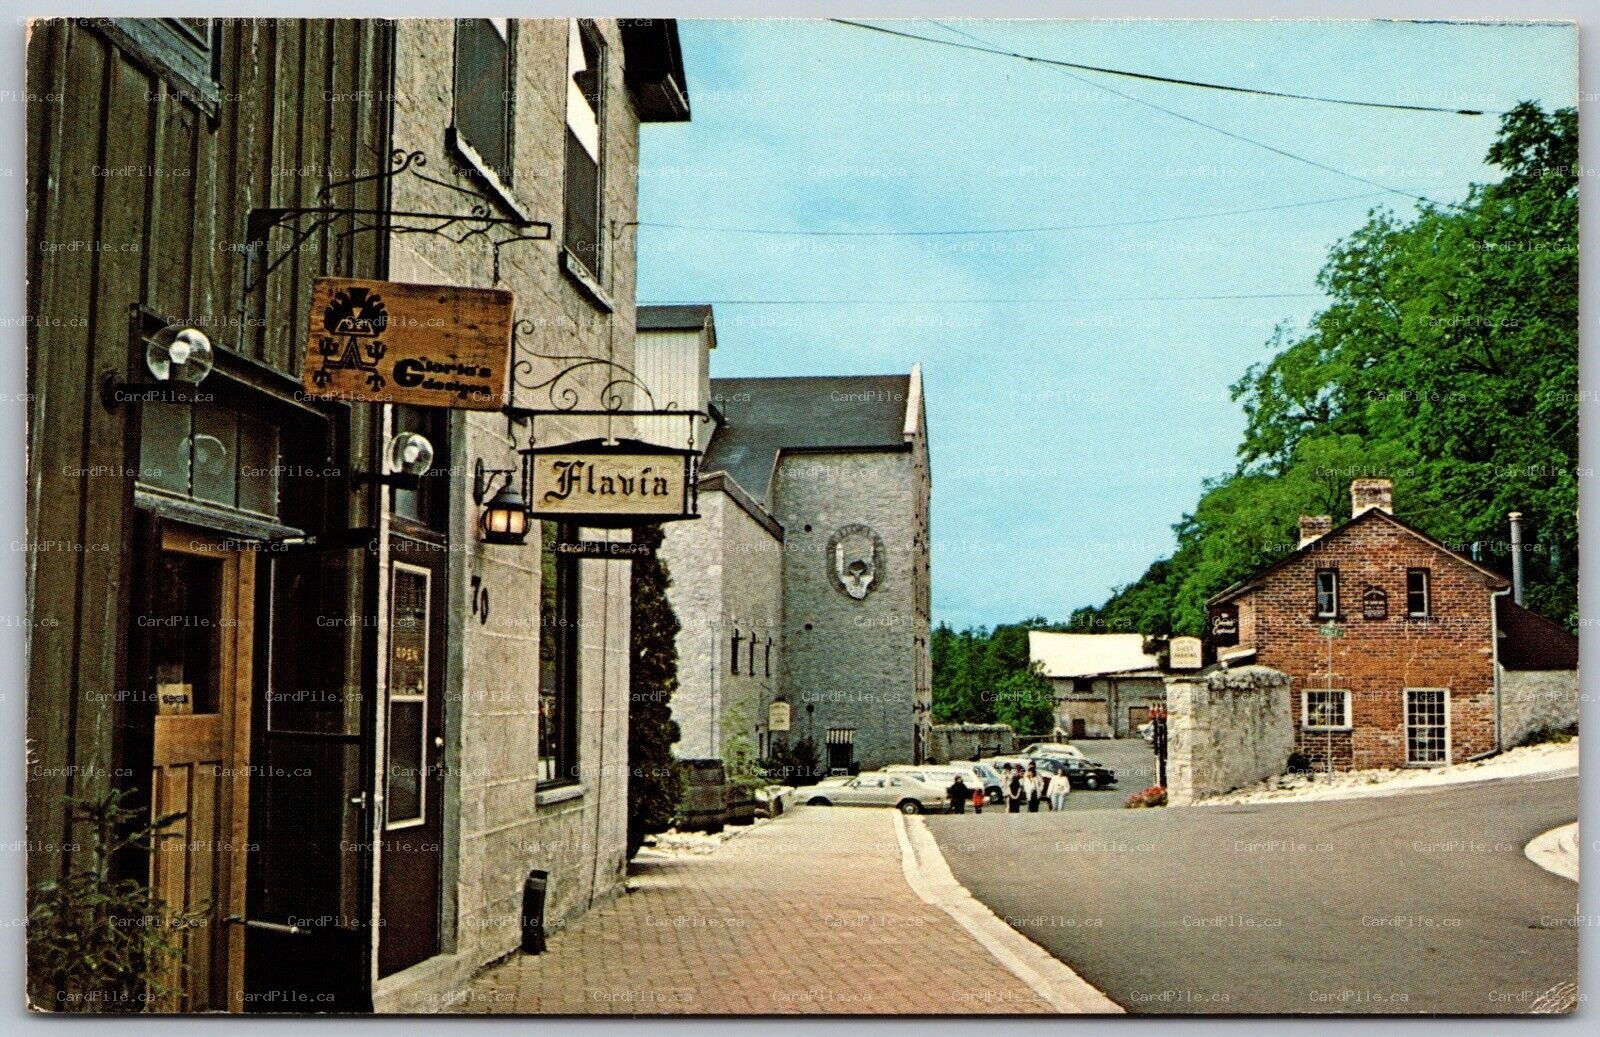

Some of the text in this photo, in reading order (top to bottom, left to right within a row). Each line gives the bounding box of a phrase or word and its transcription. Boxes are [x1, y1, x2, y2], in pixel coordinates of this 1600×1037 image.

[393, 358, 492, 387] Gloria's
[543, 460, 670, 503] Flavia
[470, 575, 489, 625] 70
